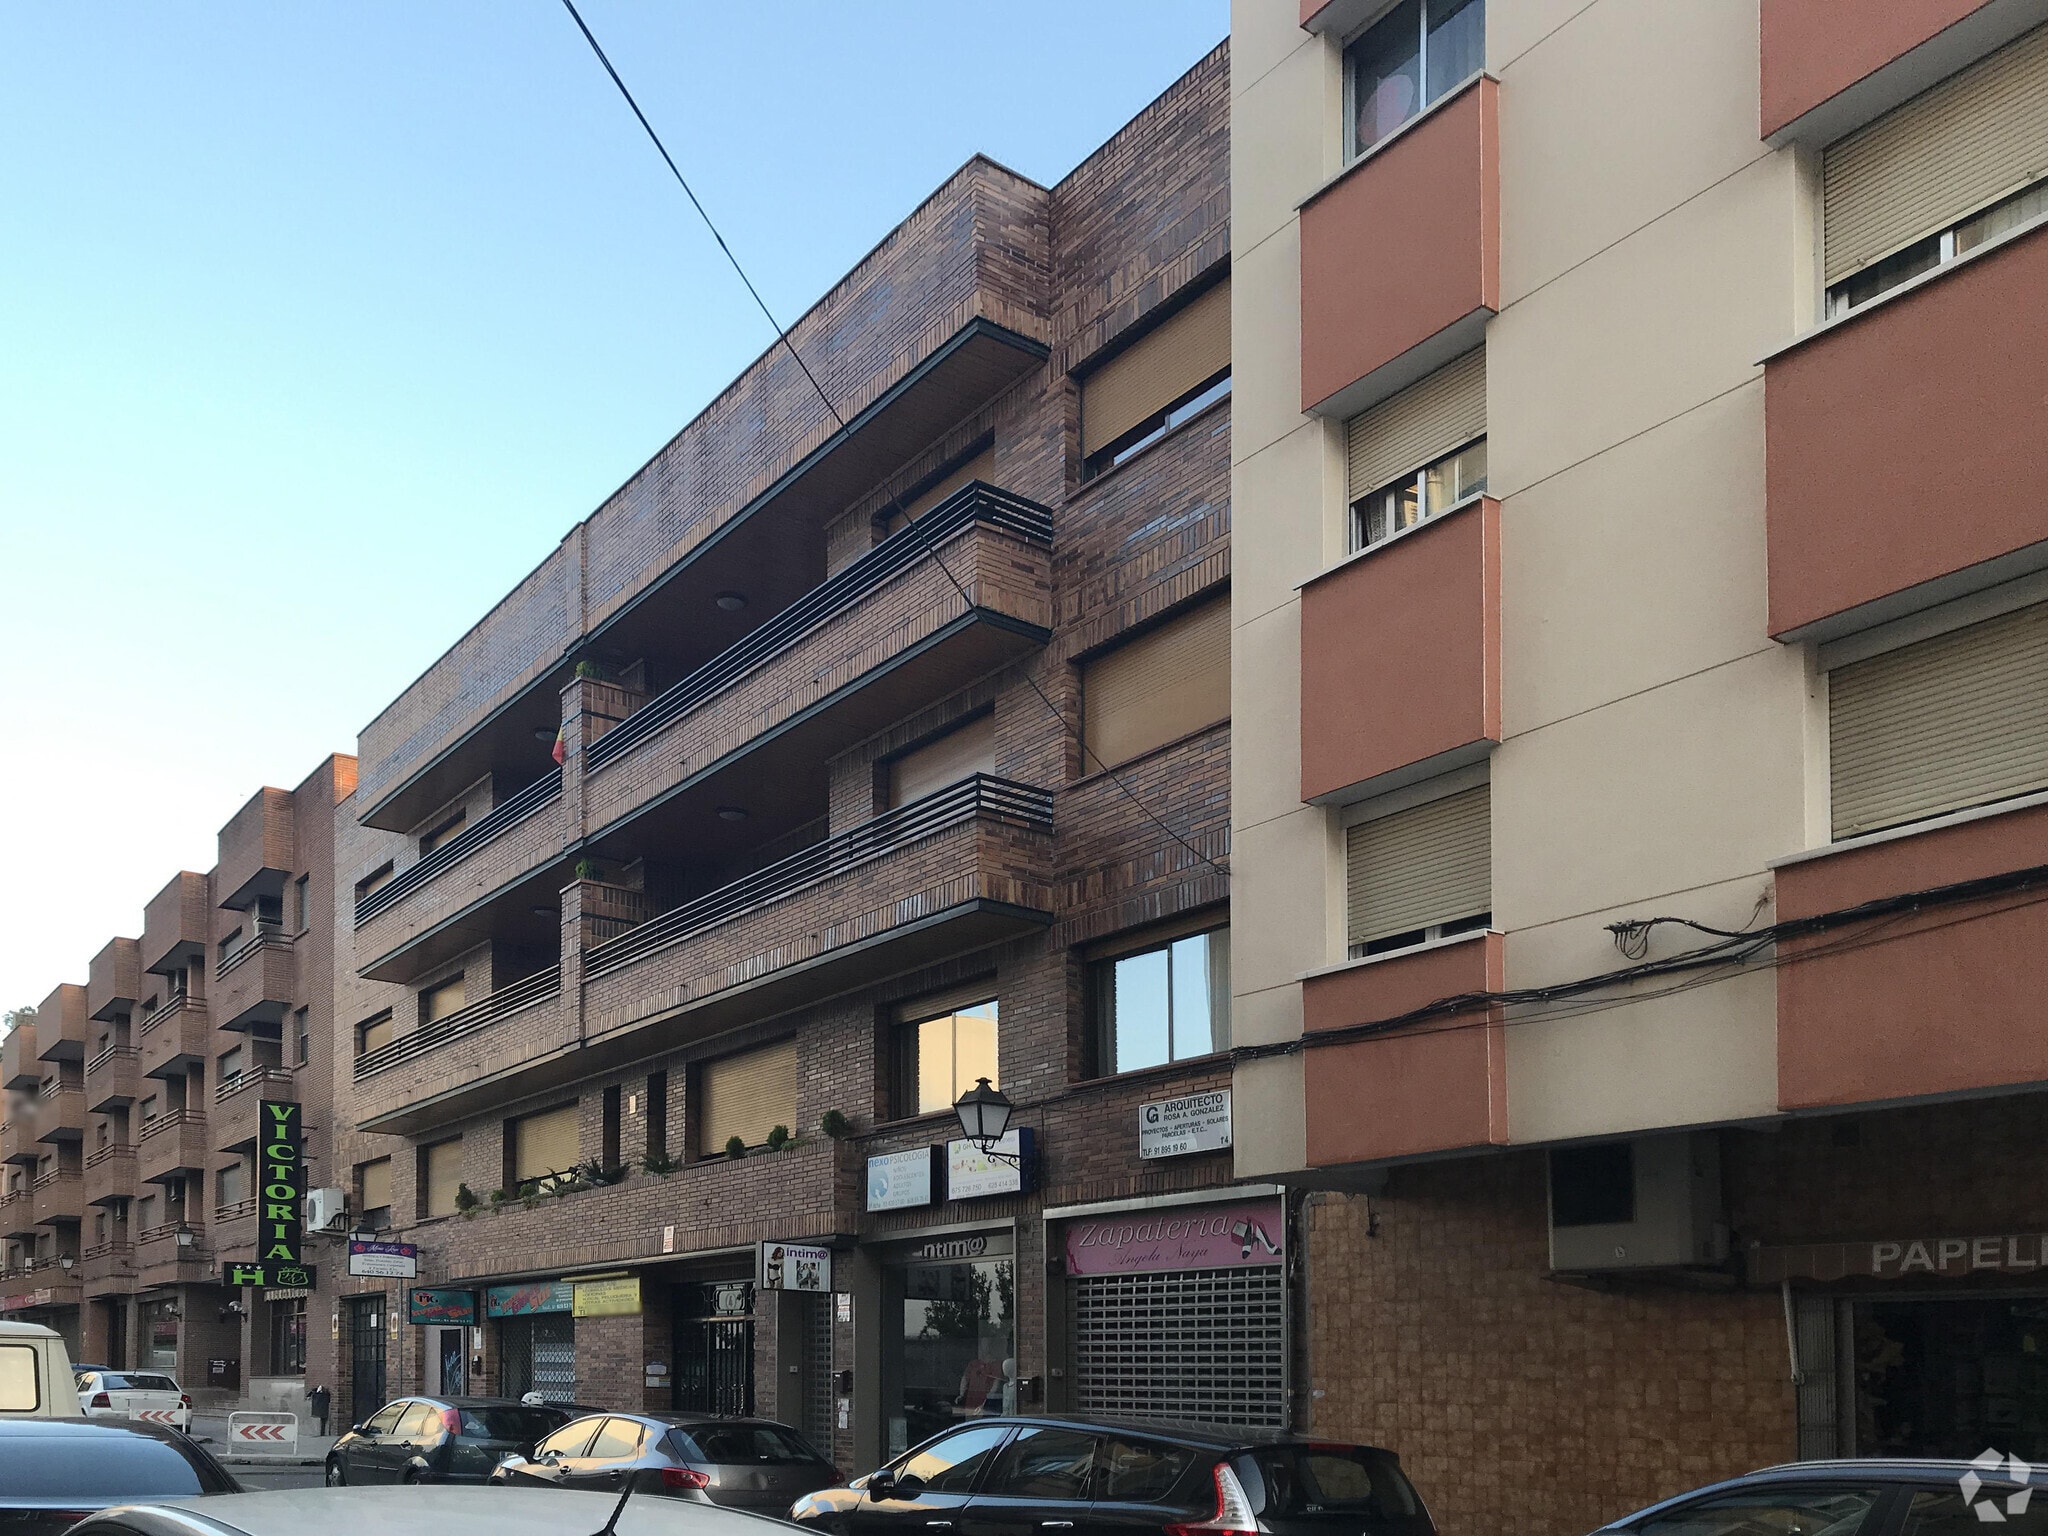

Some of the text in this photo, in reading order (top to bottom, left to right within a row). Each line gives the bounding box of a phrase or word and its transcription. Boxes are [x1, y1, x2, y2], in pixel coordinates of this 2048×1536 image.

[1164, 1094, 1223, 1113] ARQUITECTO
[1163, 1112, 1180, 1121] ROSA
[1190, 1105, 1224, 1117] GONZALEZ
[1141, 1116, 1229, 1136] PROYECTOS APERTURAS SOLARES
[1161, 1129, 1186, 1139] PARCELAS
[1153, 1146, 1160, 1155] 91
[1161, 1145, 1171, 1154] 895
[1172, 1143, 1178, 1152] 19
[1180, 1142, 1188, 1151] 60
[868, 1156, 889, 1168] nexo
[264, 1104, 297, 1260] VICTORIA
[1079, 1211, 1231, 1250] Zapatería
